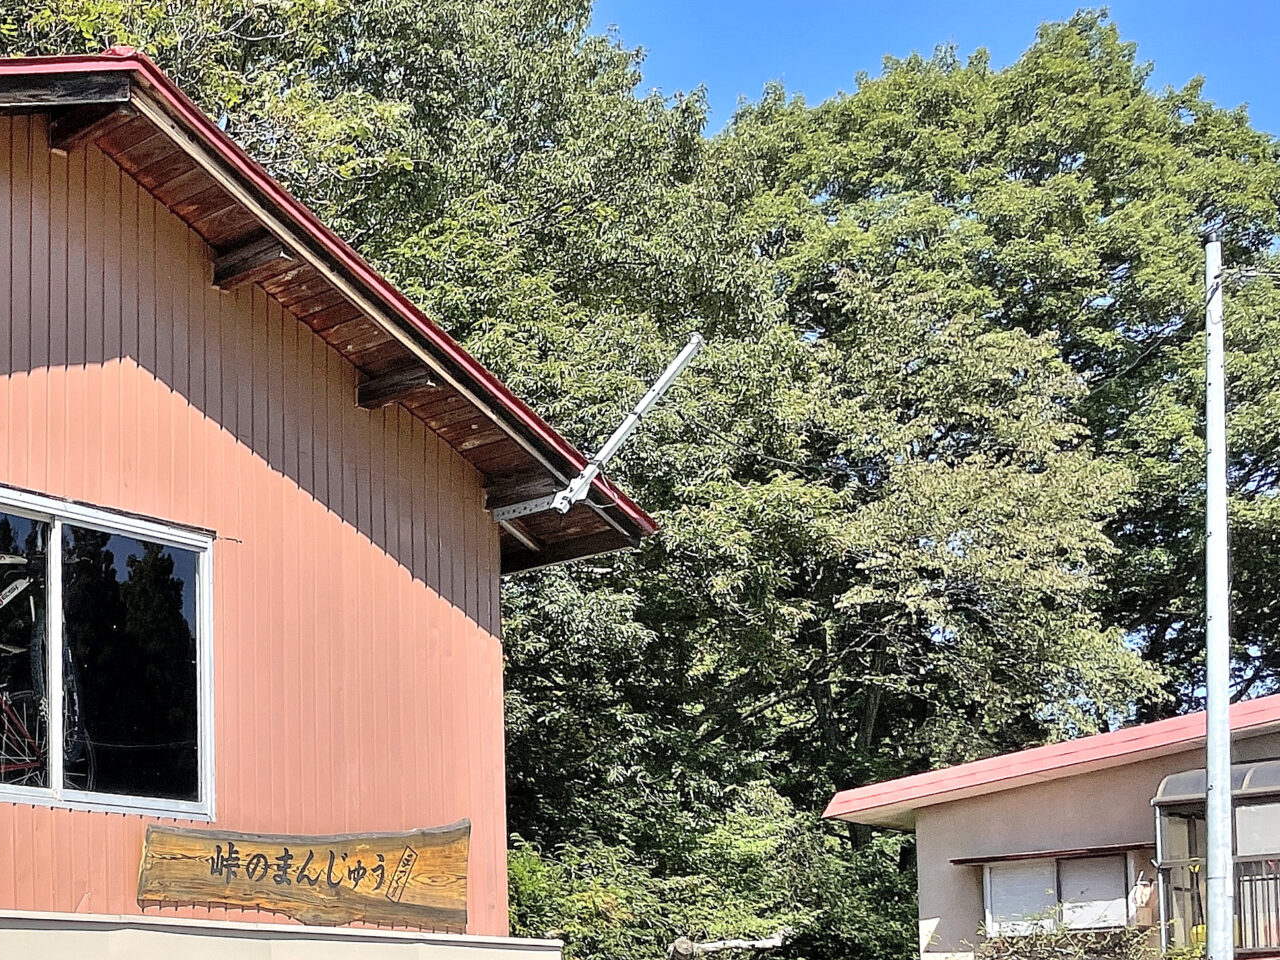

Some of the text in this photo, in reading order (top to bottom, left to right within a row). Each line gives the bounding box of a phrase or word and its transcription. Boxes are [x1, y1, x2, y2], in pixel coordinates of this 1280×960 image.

[210, 842, 386, 891] 峠のまんじゅう
